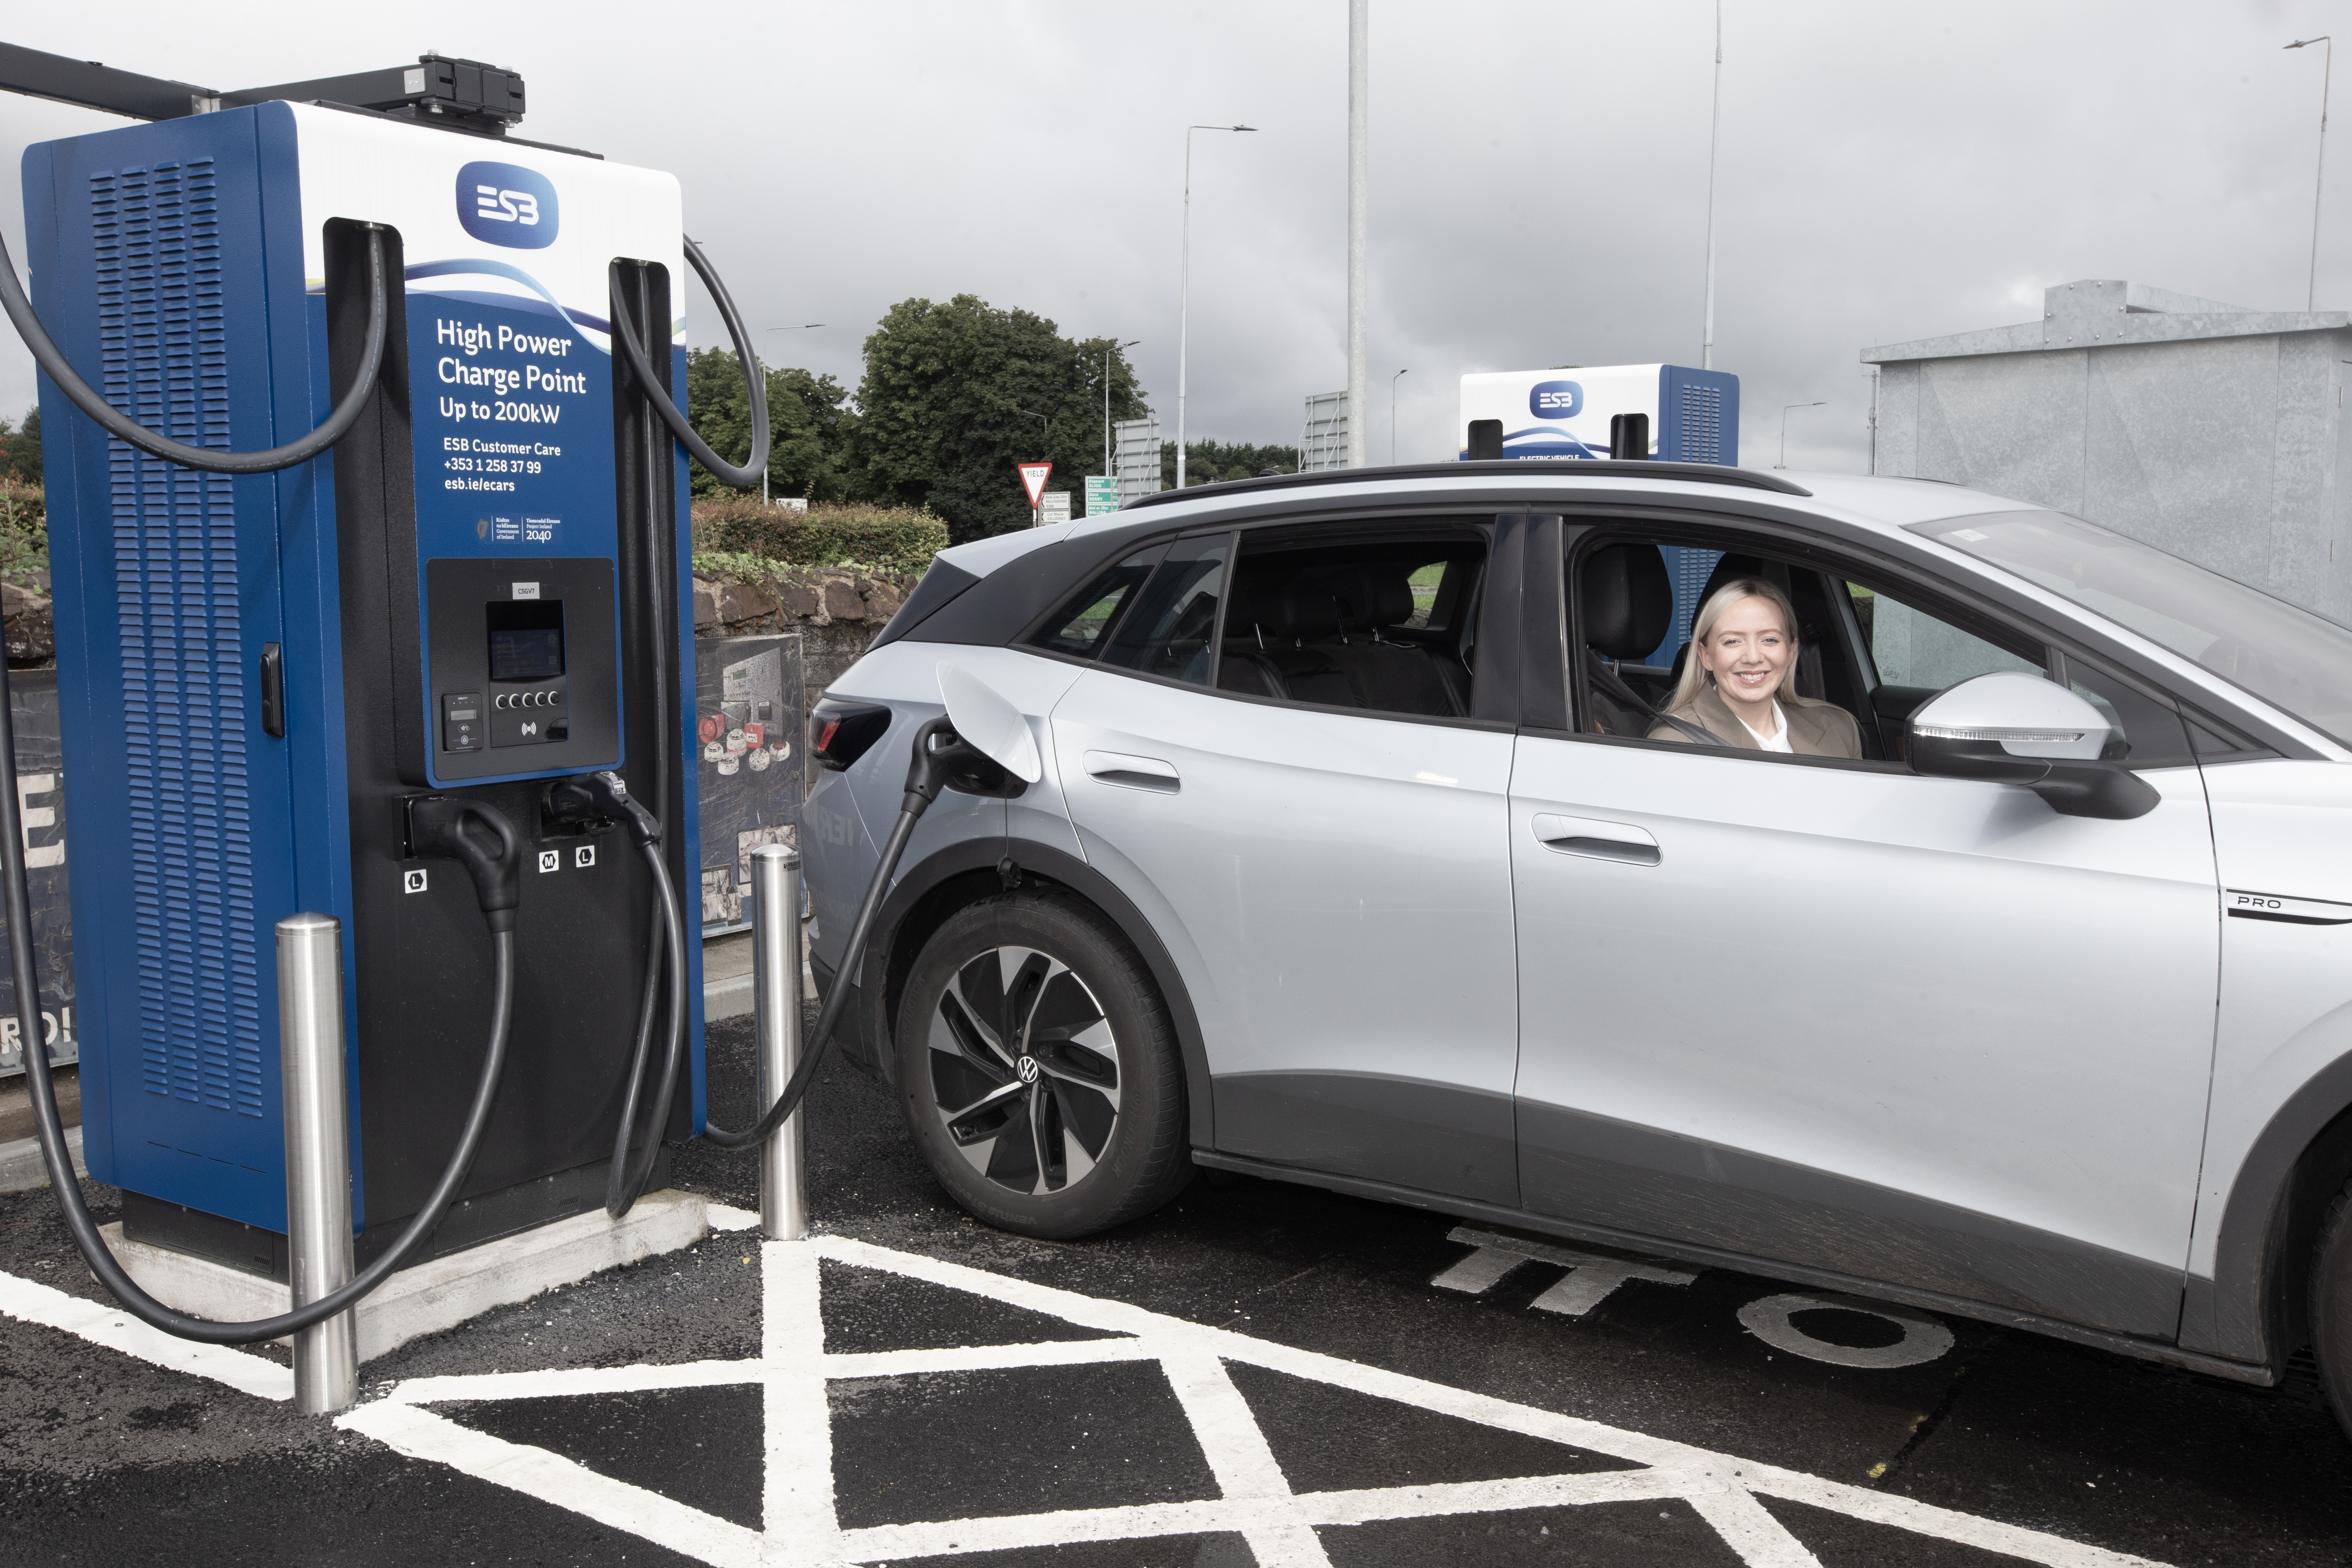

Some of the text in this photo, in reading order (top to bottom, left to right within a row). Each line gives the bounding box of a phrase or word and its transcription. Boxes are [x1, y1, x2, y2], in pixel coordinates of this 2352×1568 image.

[478, 185, 539, 225] ESB
[438, 319, 571, 356] High Power
[439, 357, 586, 395] Charge Point
[1540, 392, 1573, 408] ESB
[441, 397, 559, 423] Up to 200kW
[444, 438, 560, 456] ESB Customer Care
[444, 458, 541, 473] +353 1 258 37 99
[445, 477, 514, 491] esb.ie/ecars
[527, 530, 551, 543] 2040
[545, 856, 553, 867] M
[582, 852, 588, 861] L
[412, 876, 420, 887] L
[2237, 896, 2281, 909] PRO
